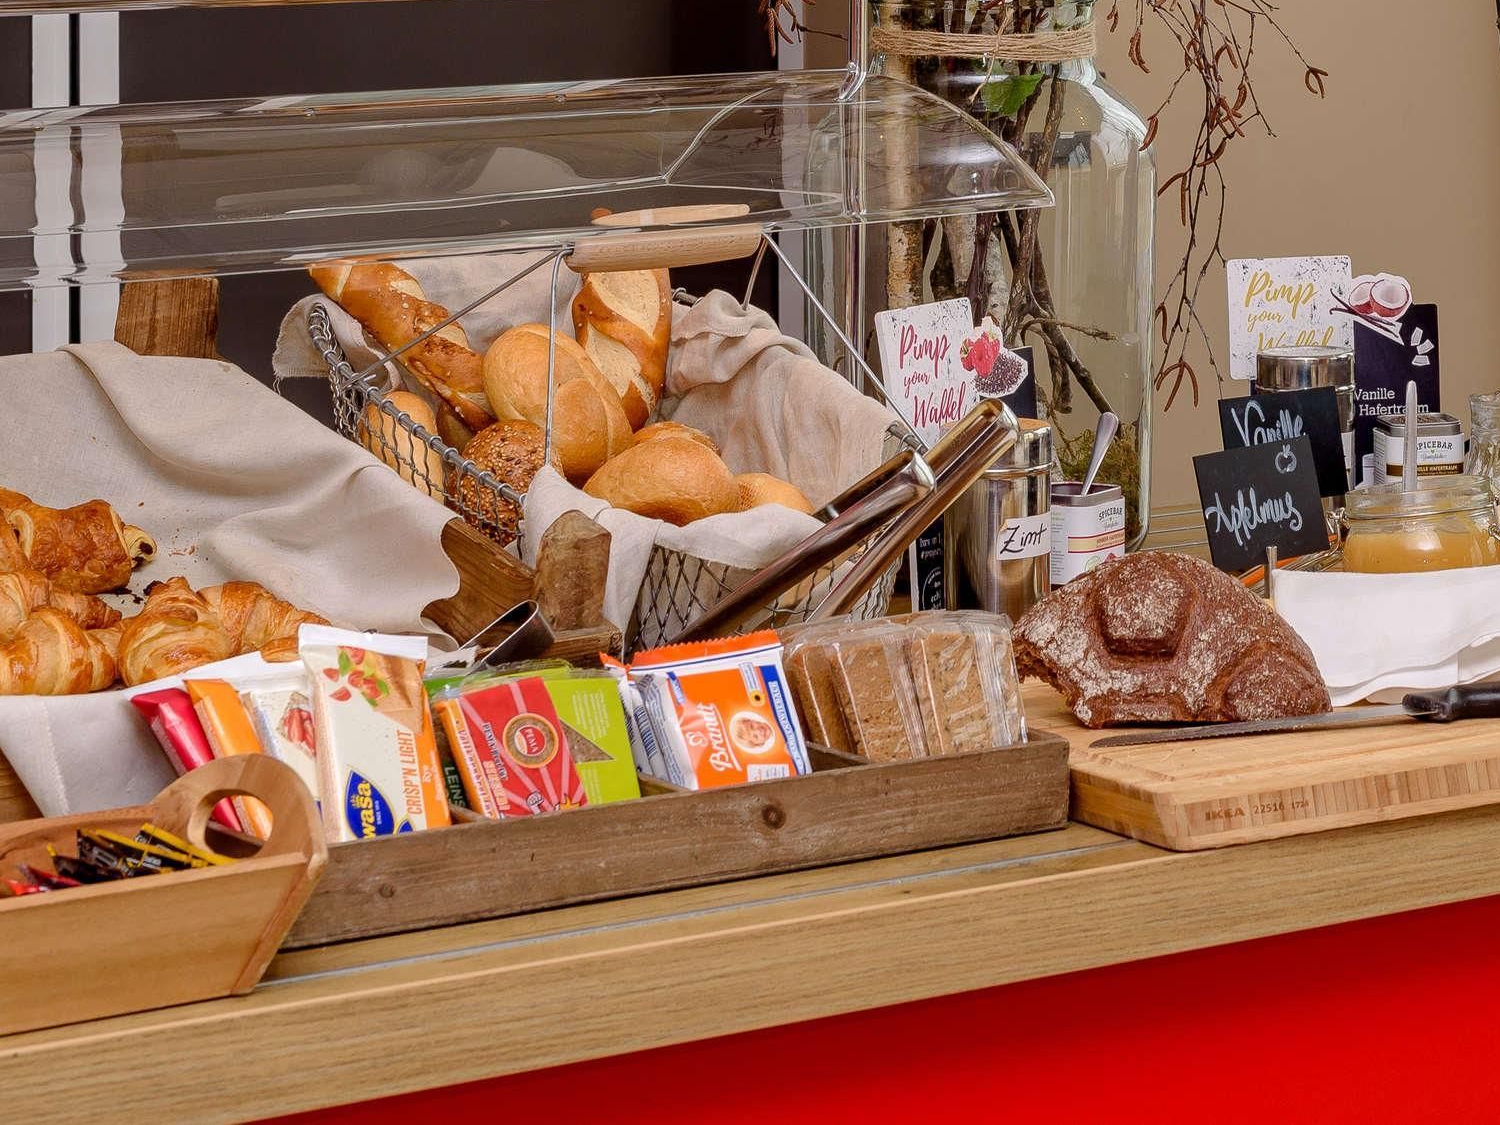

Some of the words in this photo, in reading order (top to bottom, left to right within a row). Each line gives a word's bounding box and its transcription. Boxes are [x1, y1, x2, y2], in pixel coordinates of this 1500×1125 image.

[1244, 271, 1318, 319] Pimp
[1247, 309, 1287, 332] your
[899, 325, 951, 379] Pimp
[903, 370, 930, 399] your
[1354, 387, 1395, 401] Vanille
[912, 381, 967, 428] Waffel
[1359, 403, 1430, 416] Hafertram
[1416, 440, 1453, 451] PICEBAR
[1098, 506, 1124, 521] SPICEBAR
[1204, 486, 1304, 547] Apfelmus
[999, 522, 1048, 555] Zimt
[397, 729, 416, 765] LIGHT
[525, 727, 539, 753] PEMA
[697, 701, 734, 772] Brandt
[1204, 807, 1246, 821] IKEA
[1253, 801, 1285, 815] 22516
